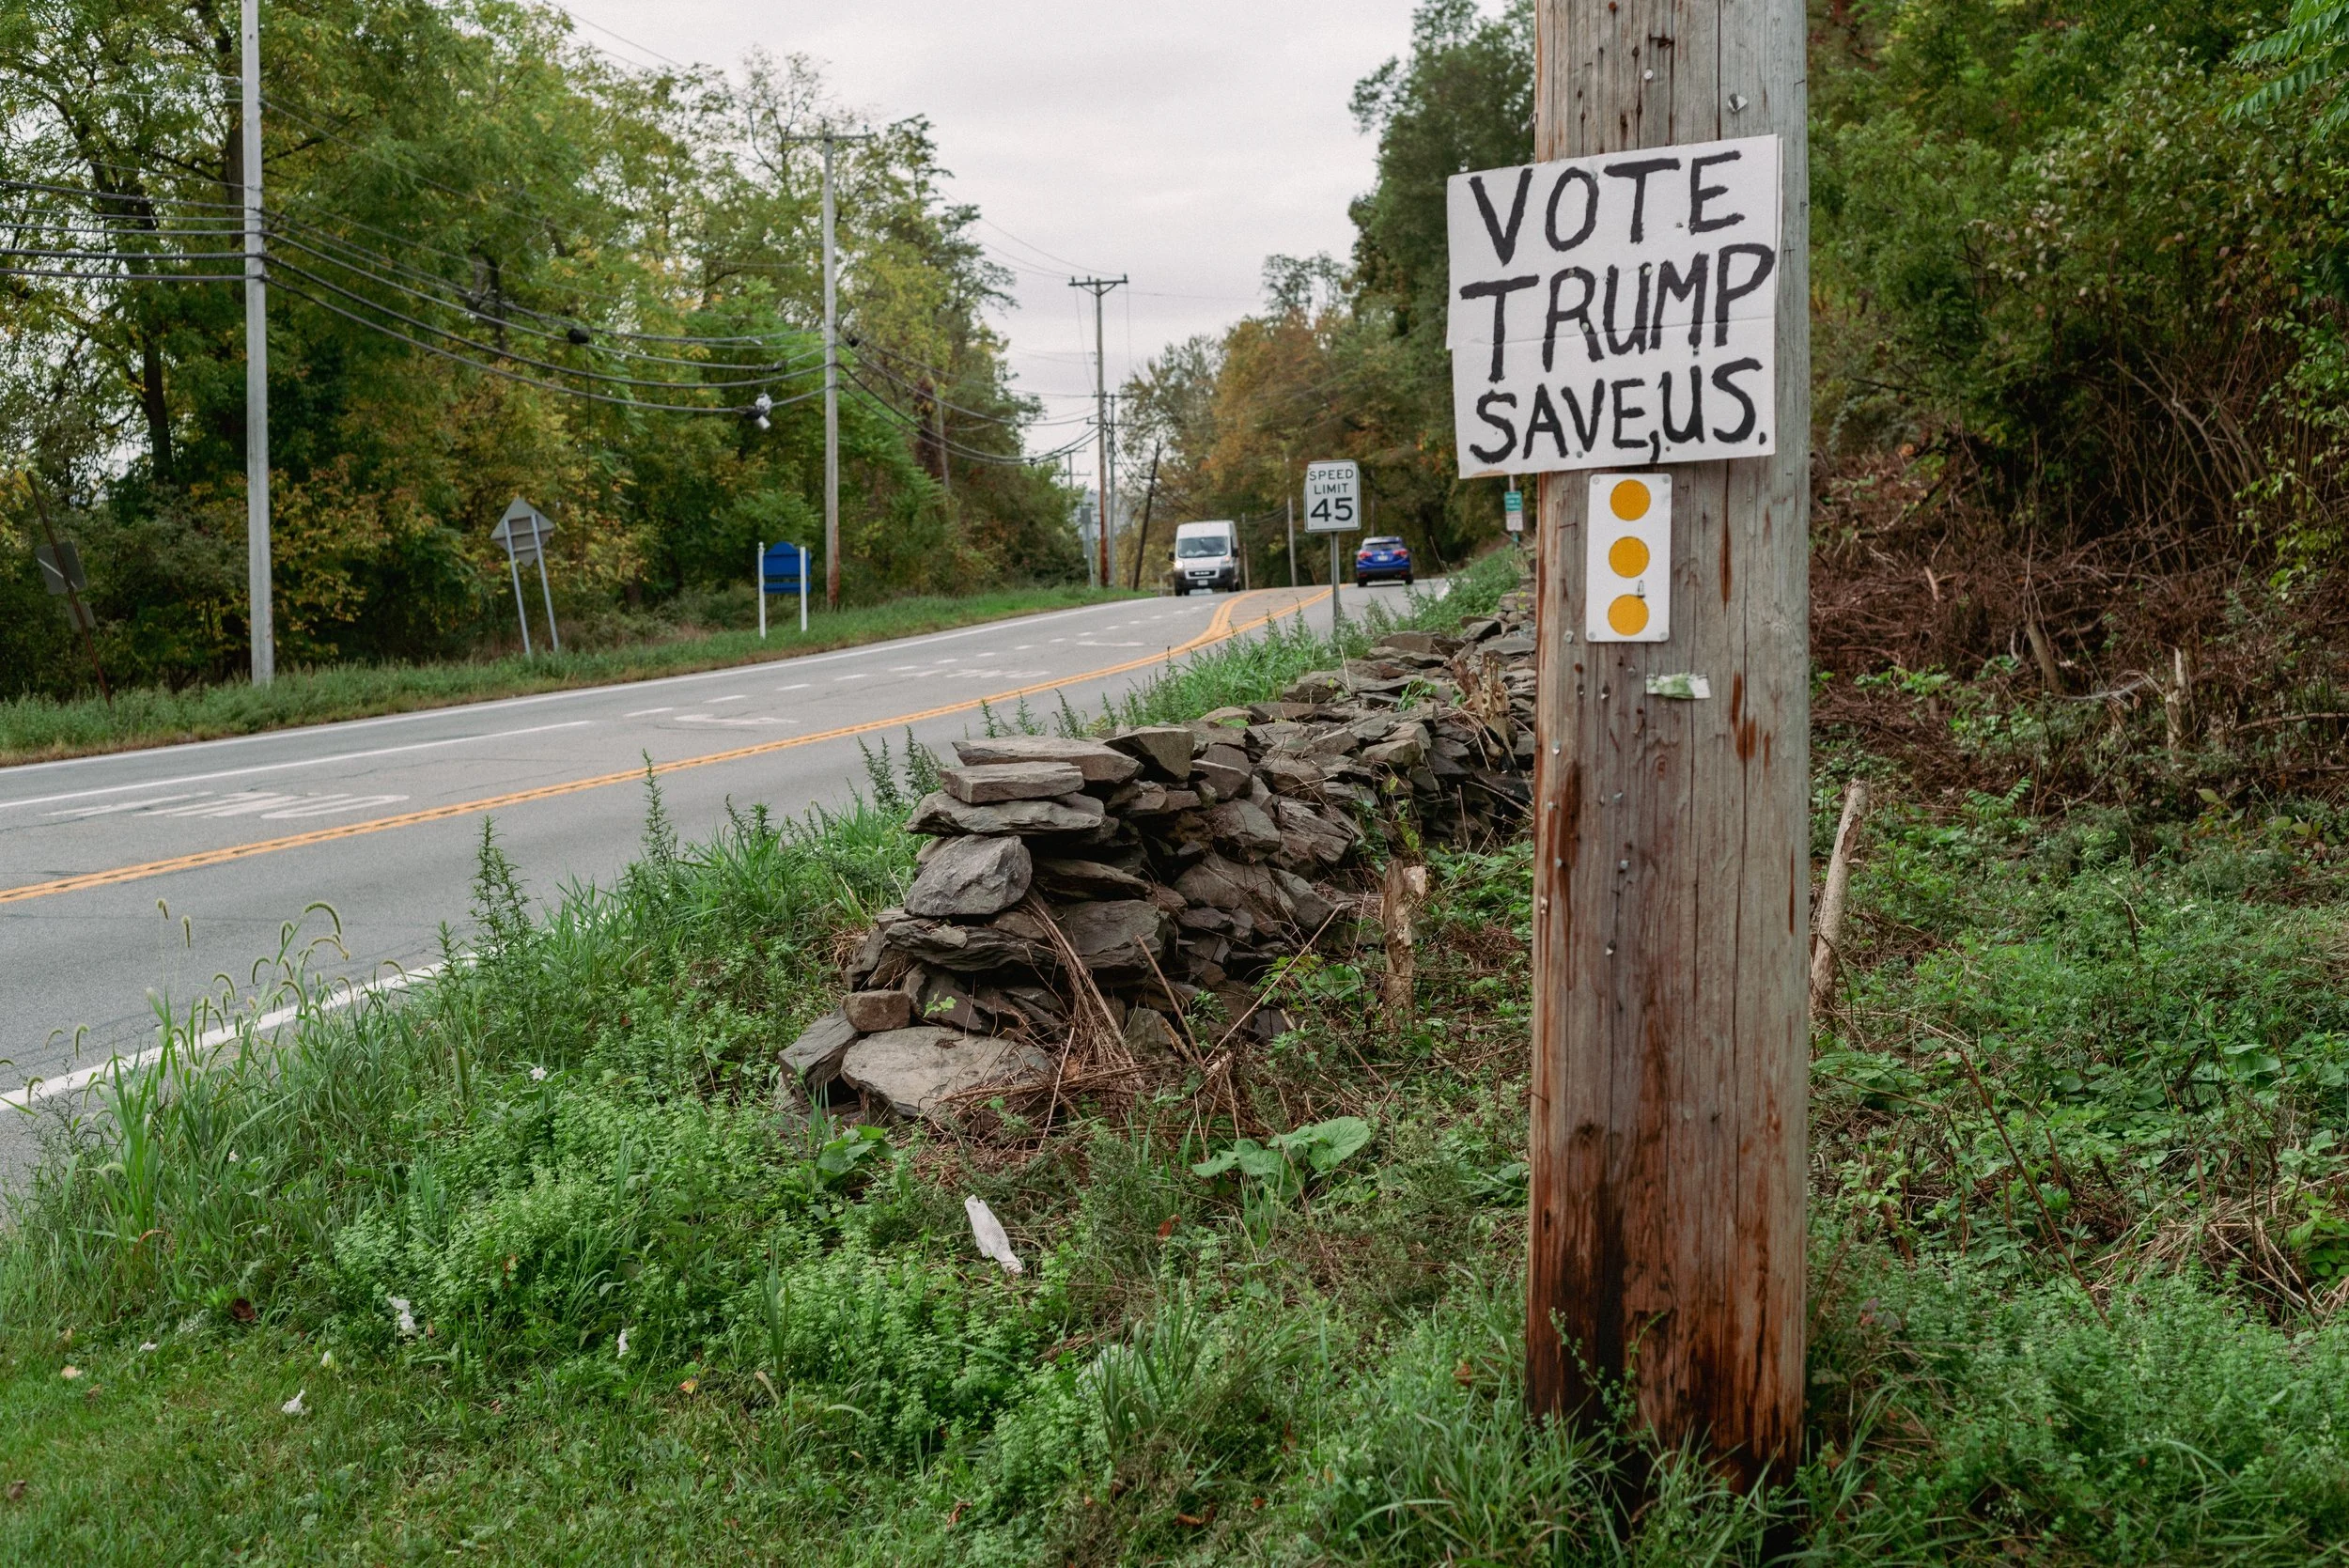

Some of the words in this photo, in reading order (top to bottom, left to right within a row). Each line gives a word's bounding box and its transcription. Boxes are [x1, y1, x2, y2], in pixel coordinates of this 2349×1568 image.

[1468, 149, 1746, 266] VOTE
[1459, 242, 1776, 383] TRUMP
[1309, 469, 1354, 481] SPEED
[1314, 483, 1348, 495] LIMIT
[1310, 496, 1353, 522] 45
